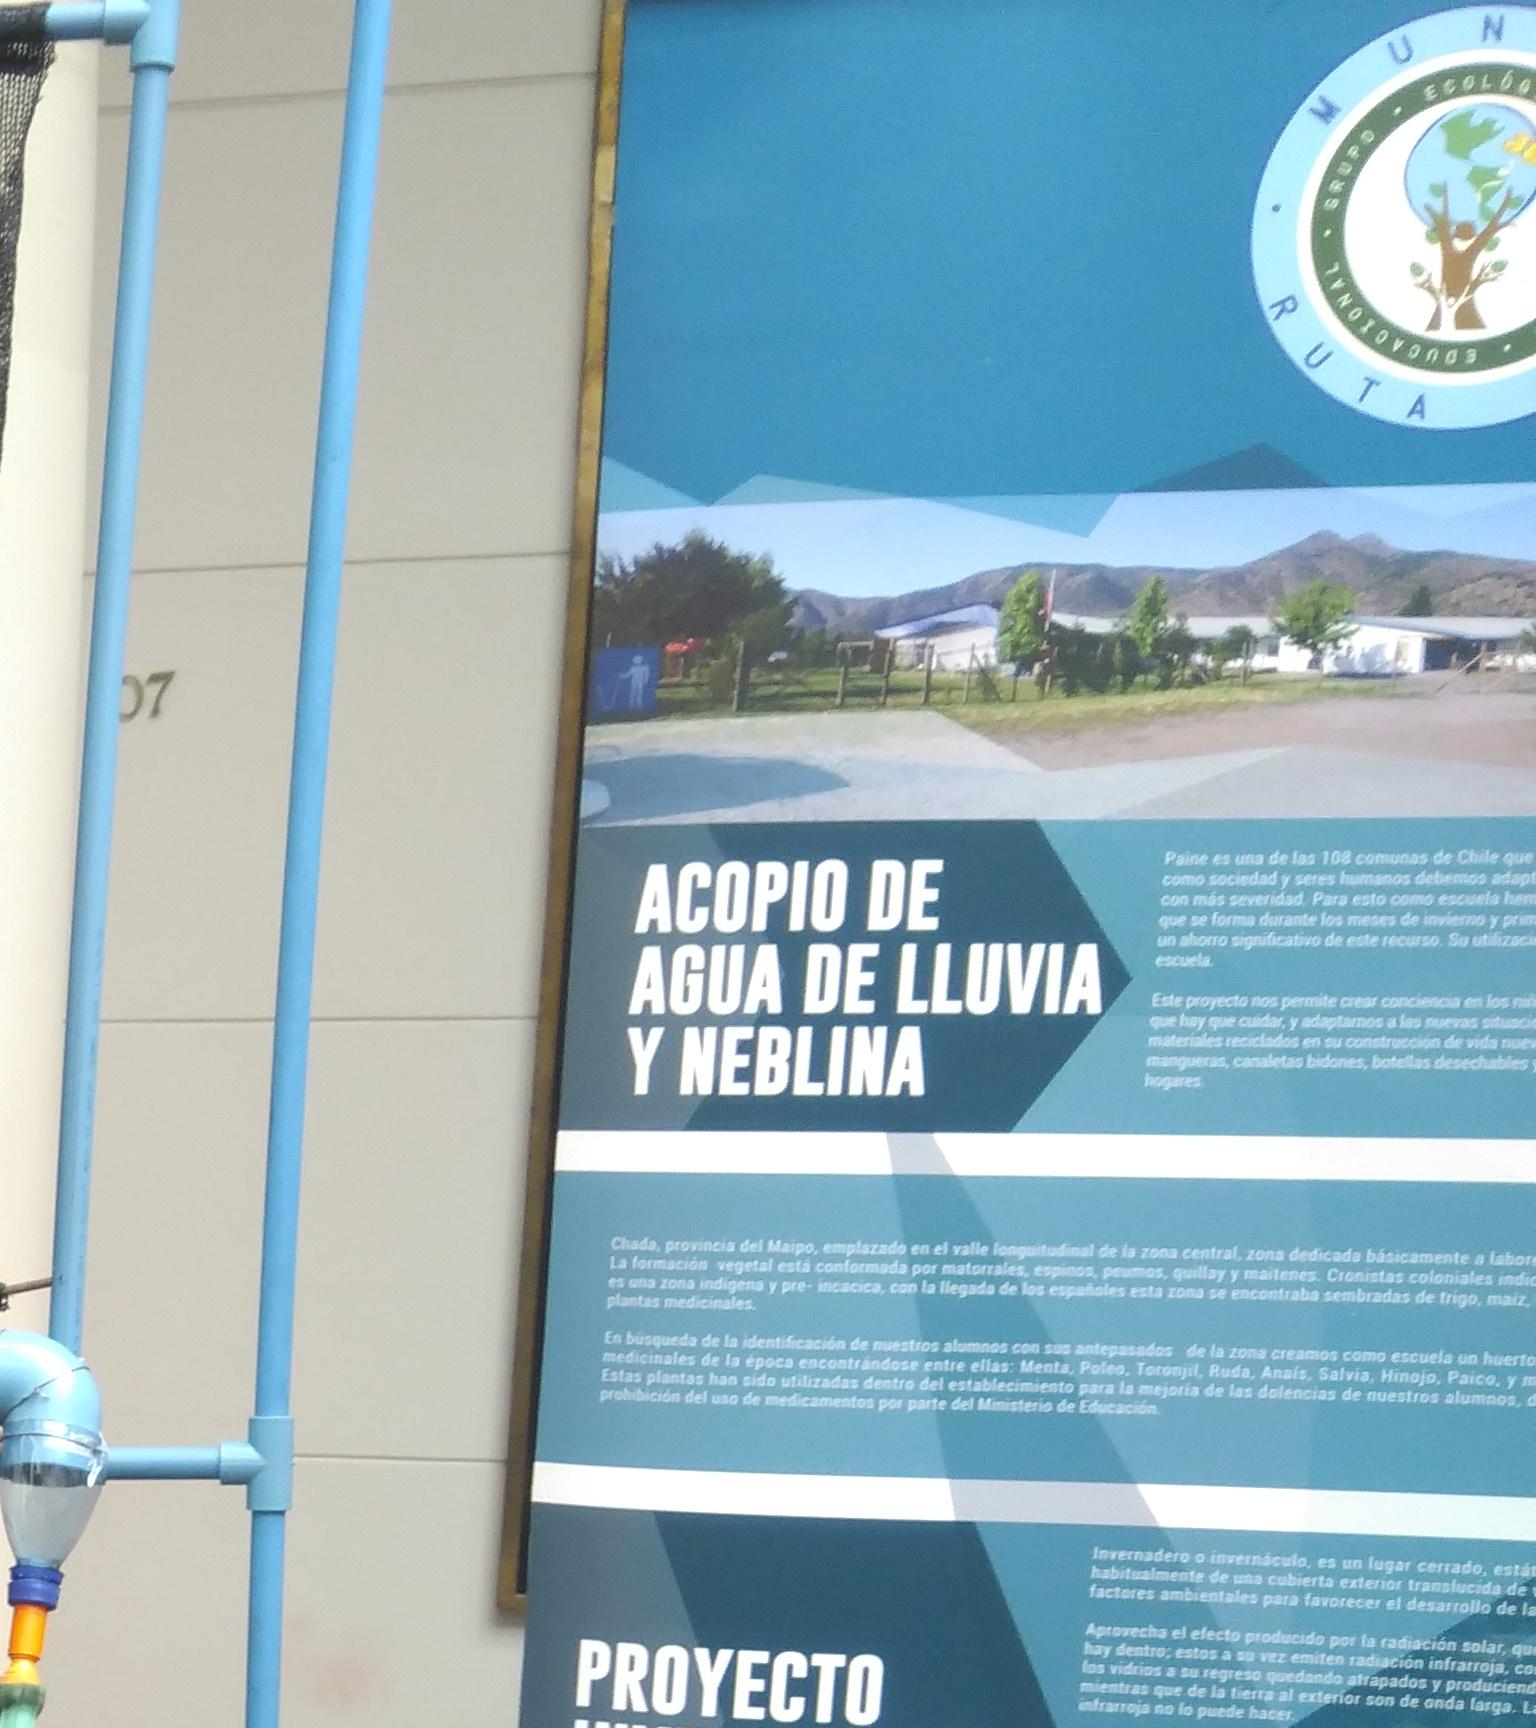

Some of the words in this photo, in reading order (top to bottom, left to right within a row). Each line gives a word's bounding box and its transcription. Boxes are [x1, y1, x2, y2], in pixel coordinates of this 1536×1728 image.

[635, 859, 848, 933] ACOPIO
[868, 860, 943, 930] DE
[629, 944, 782, 1015] AGUA
[804, 944, 879, 1013] DE
[897, 943, 1101, 1014] LLUVIA
[628, 1027, 664, 1095] Y
[680, 1026, 924, 1096] NEBLINA
[574, 1639, 883, 1727] PROYECTO
